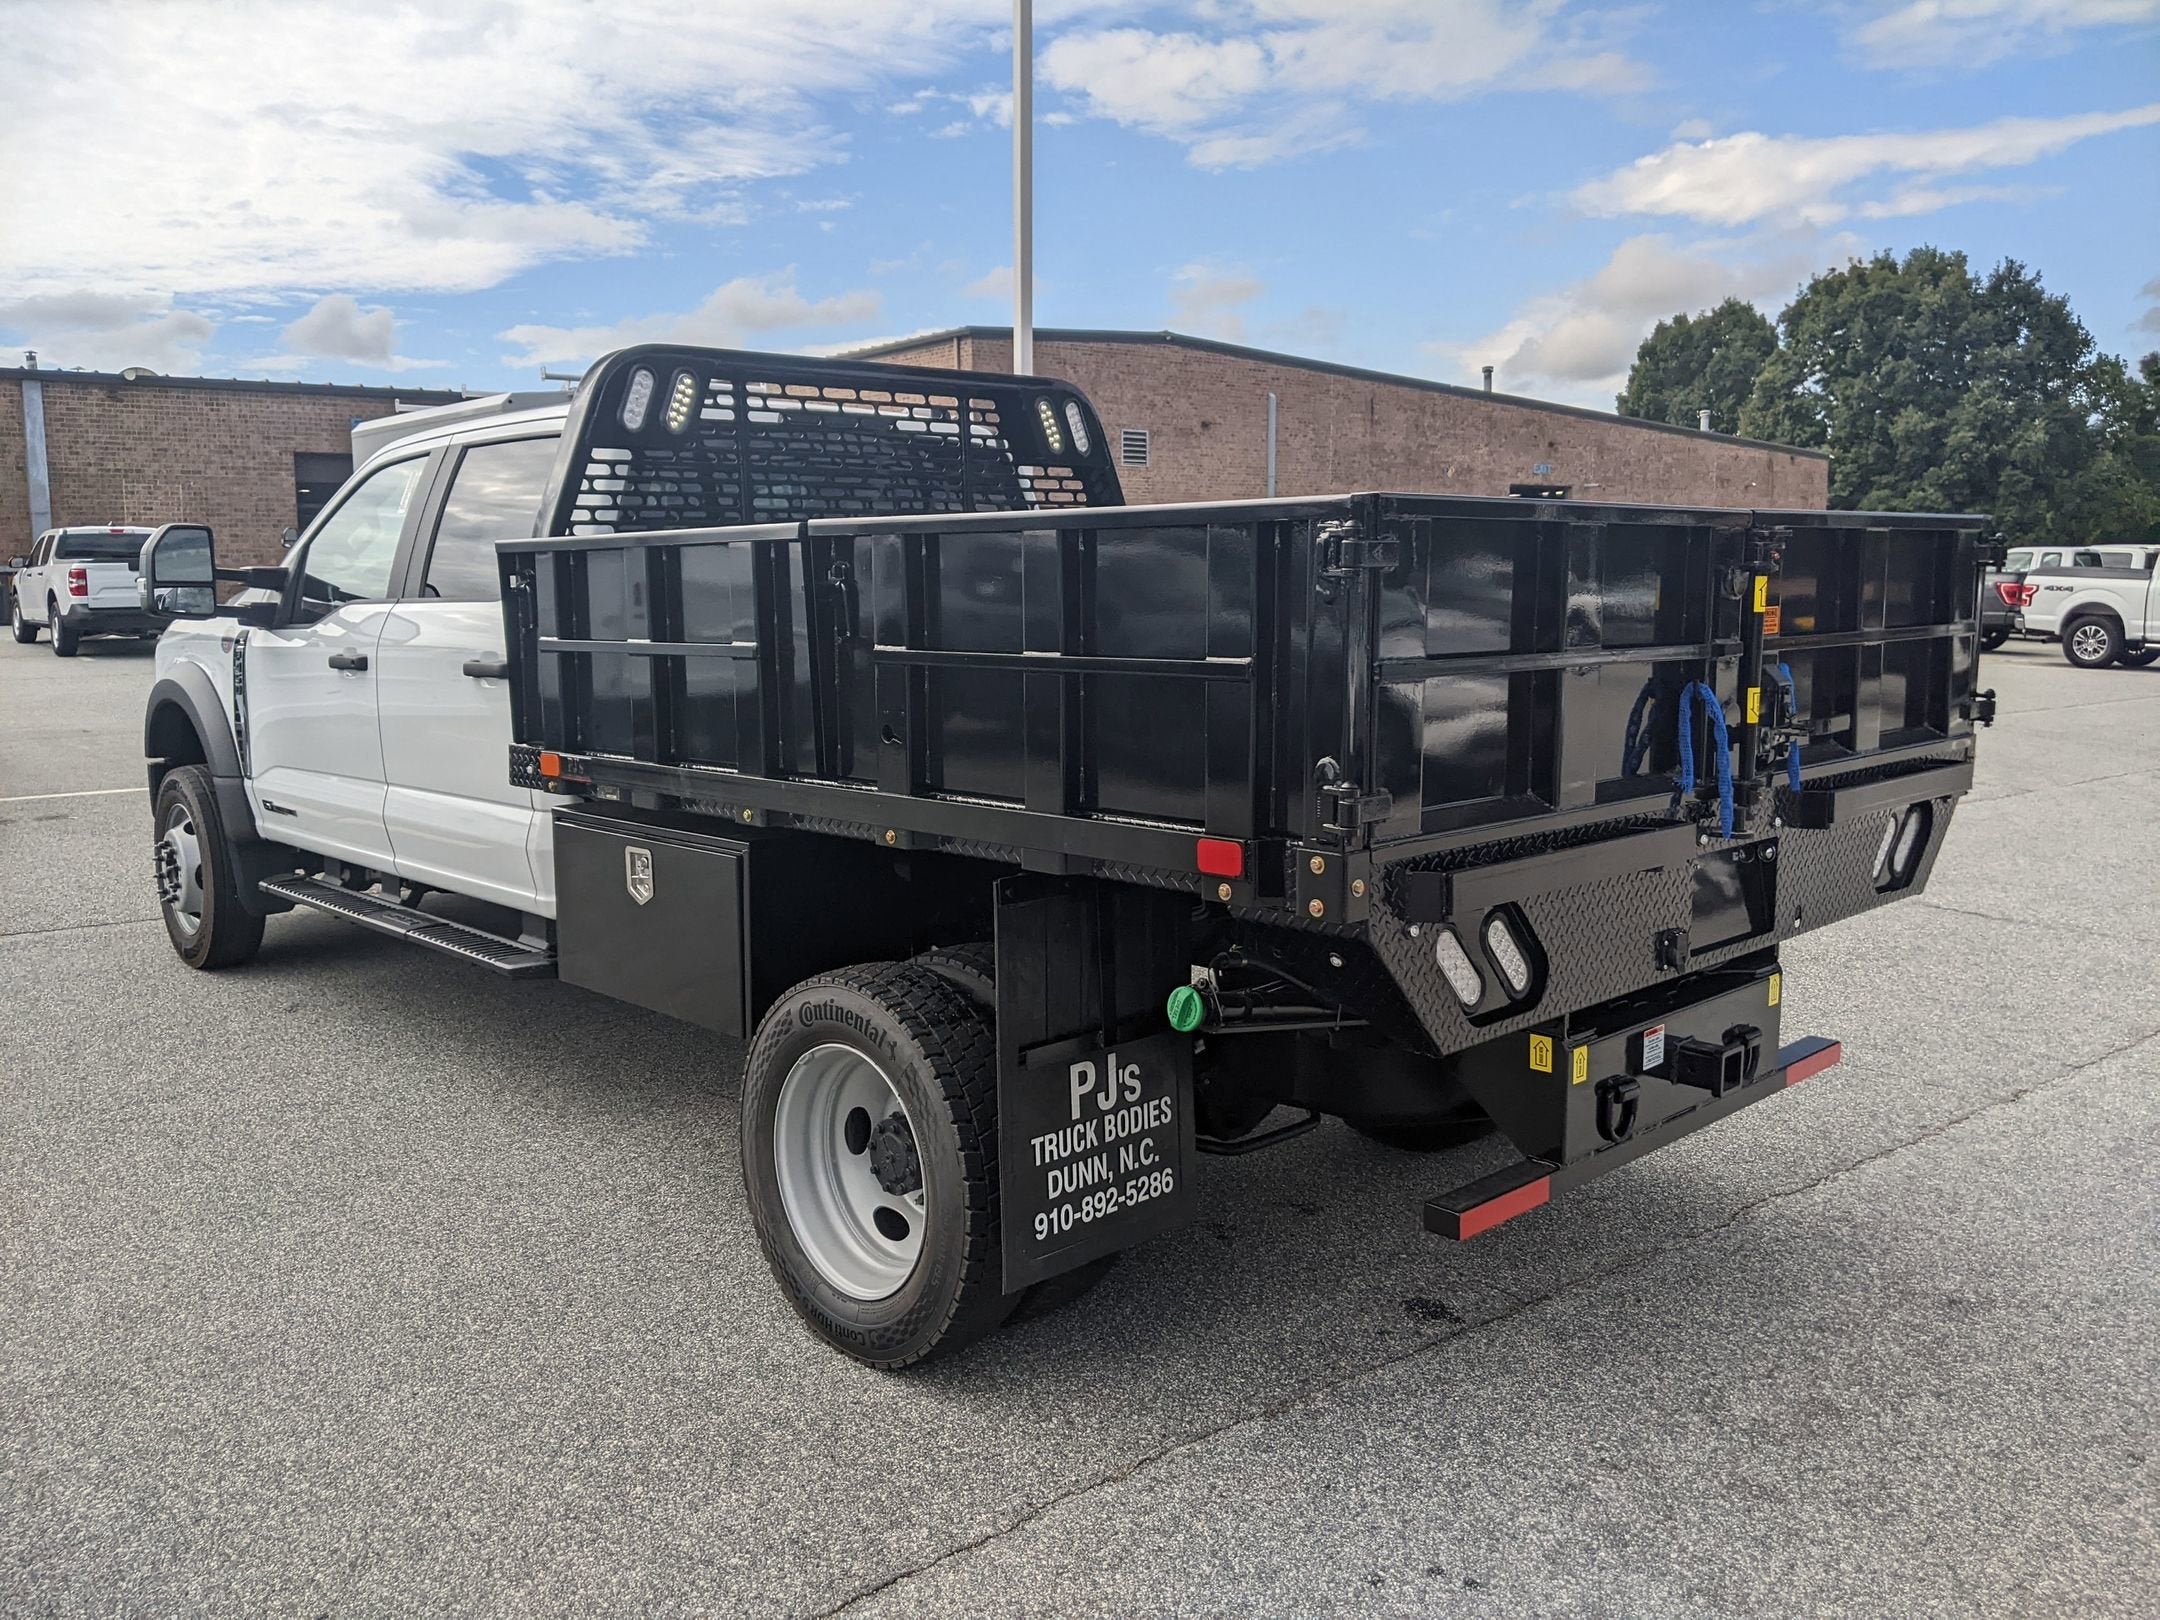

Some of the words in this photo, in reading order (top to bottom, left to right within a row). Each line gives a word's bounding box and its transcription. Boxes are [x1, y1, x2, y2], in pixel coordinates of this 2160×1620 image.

[799, 998, 887, 1049] Continental
[1070, 1053, 1142, 1120] PJ's
[1031, 1118, 1098, 1167] TRUCK
[1104, 1095, 1172, 1143] BODIES
[1048, 1152, 1114, 1200] DUNN,
[1119, 1137, 1160, 1174] N.C.
[1034, 1167, 1174, 1240] 910-892-5286
